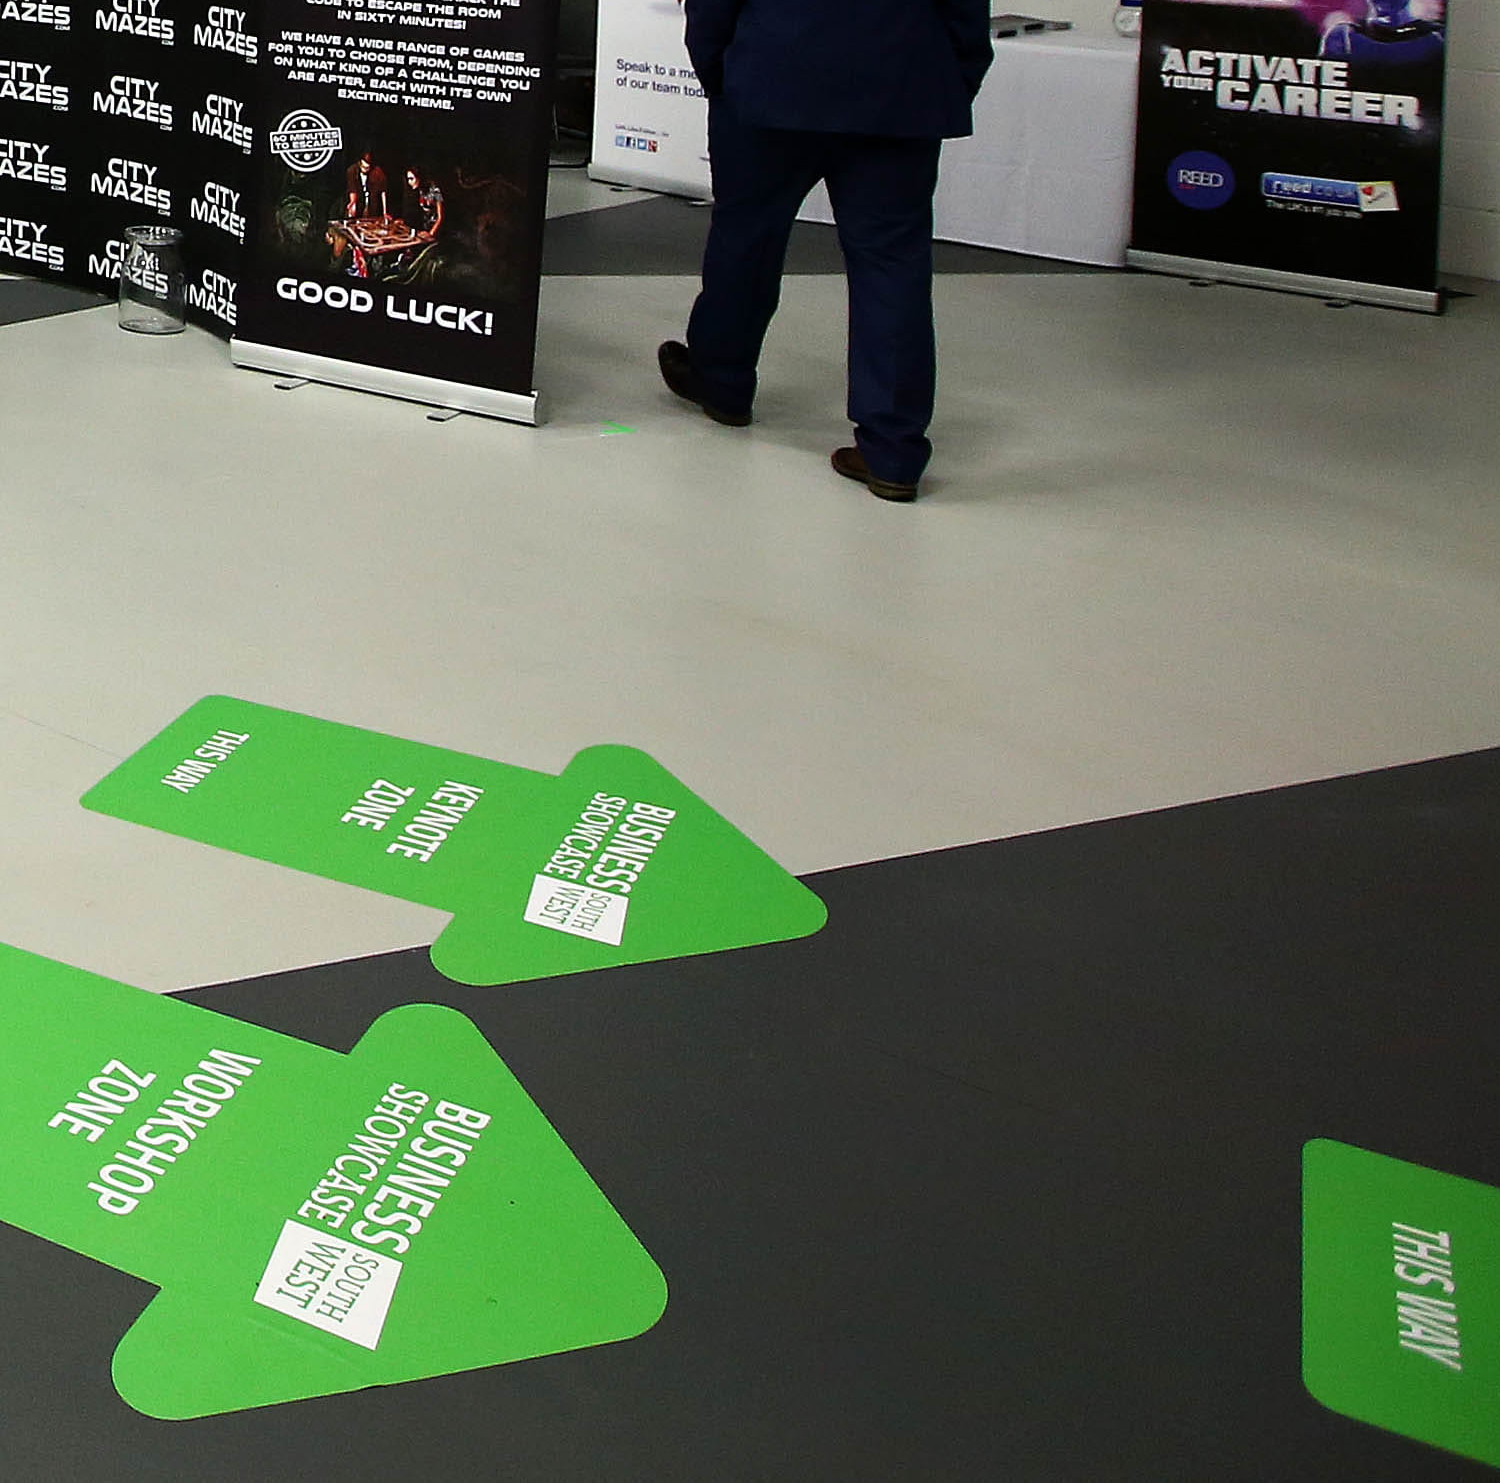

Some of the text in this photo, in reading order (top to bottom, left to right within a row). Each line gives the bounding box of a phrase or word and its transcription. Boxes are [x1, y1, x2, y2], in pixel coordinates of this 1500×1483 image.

[616, 58, 652, 73] Speak
[654, 63, 667, 76] to
[669, 67, 677, 77] a
[616, 75, 681, 94] of our team
[1161, 47, 1349, 87] ACTIVATE
[1160, 74, 1423, 130] YOUR CAREER
[1178, 169, 1223, 187] REED
[276, 277, 494, 336] GOOD LUCK!
[160, 729, 251, 794] THIS WAY
[340, 779, 416, 831] ZONE
[386, 780, 485, 863] KEYNOTE
[543, 792, 628, 880] SHOWCASE
[586, 802, 677, 894] BUSINESS
[539, 886, 585, 925] WEST
[571, 892, 612, 932] SOUTH
[47, 1058, 157, 1143] ZONE
[88, 1048, 262, 1216] WORKSHOP
[297, 1082, 430, 1230] SHOWCASE
[350, 1099, 492, 1254] BUSINESS
[276, 1241, 347, 1309] WEST
[316, 1252, 380, 1323] SOUTH
[1392, 1222, 1462, 1372] THIS WAY
